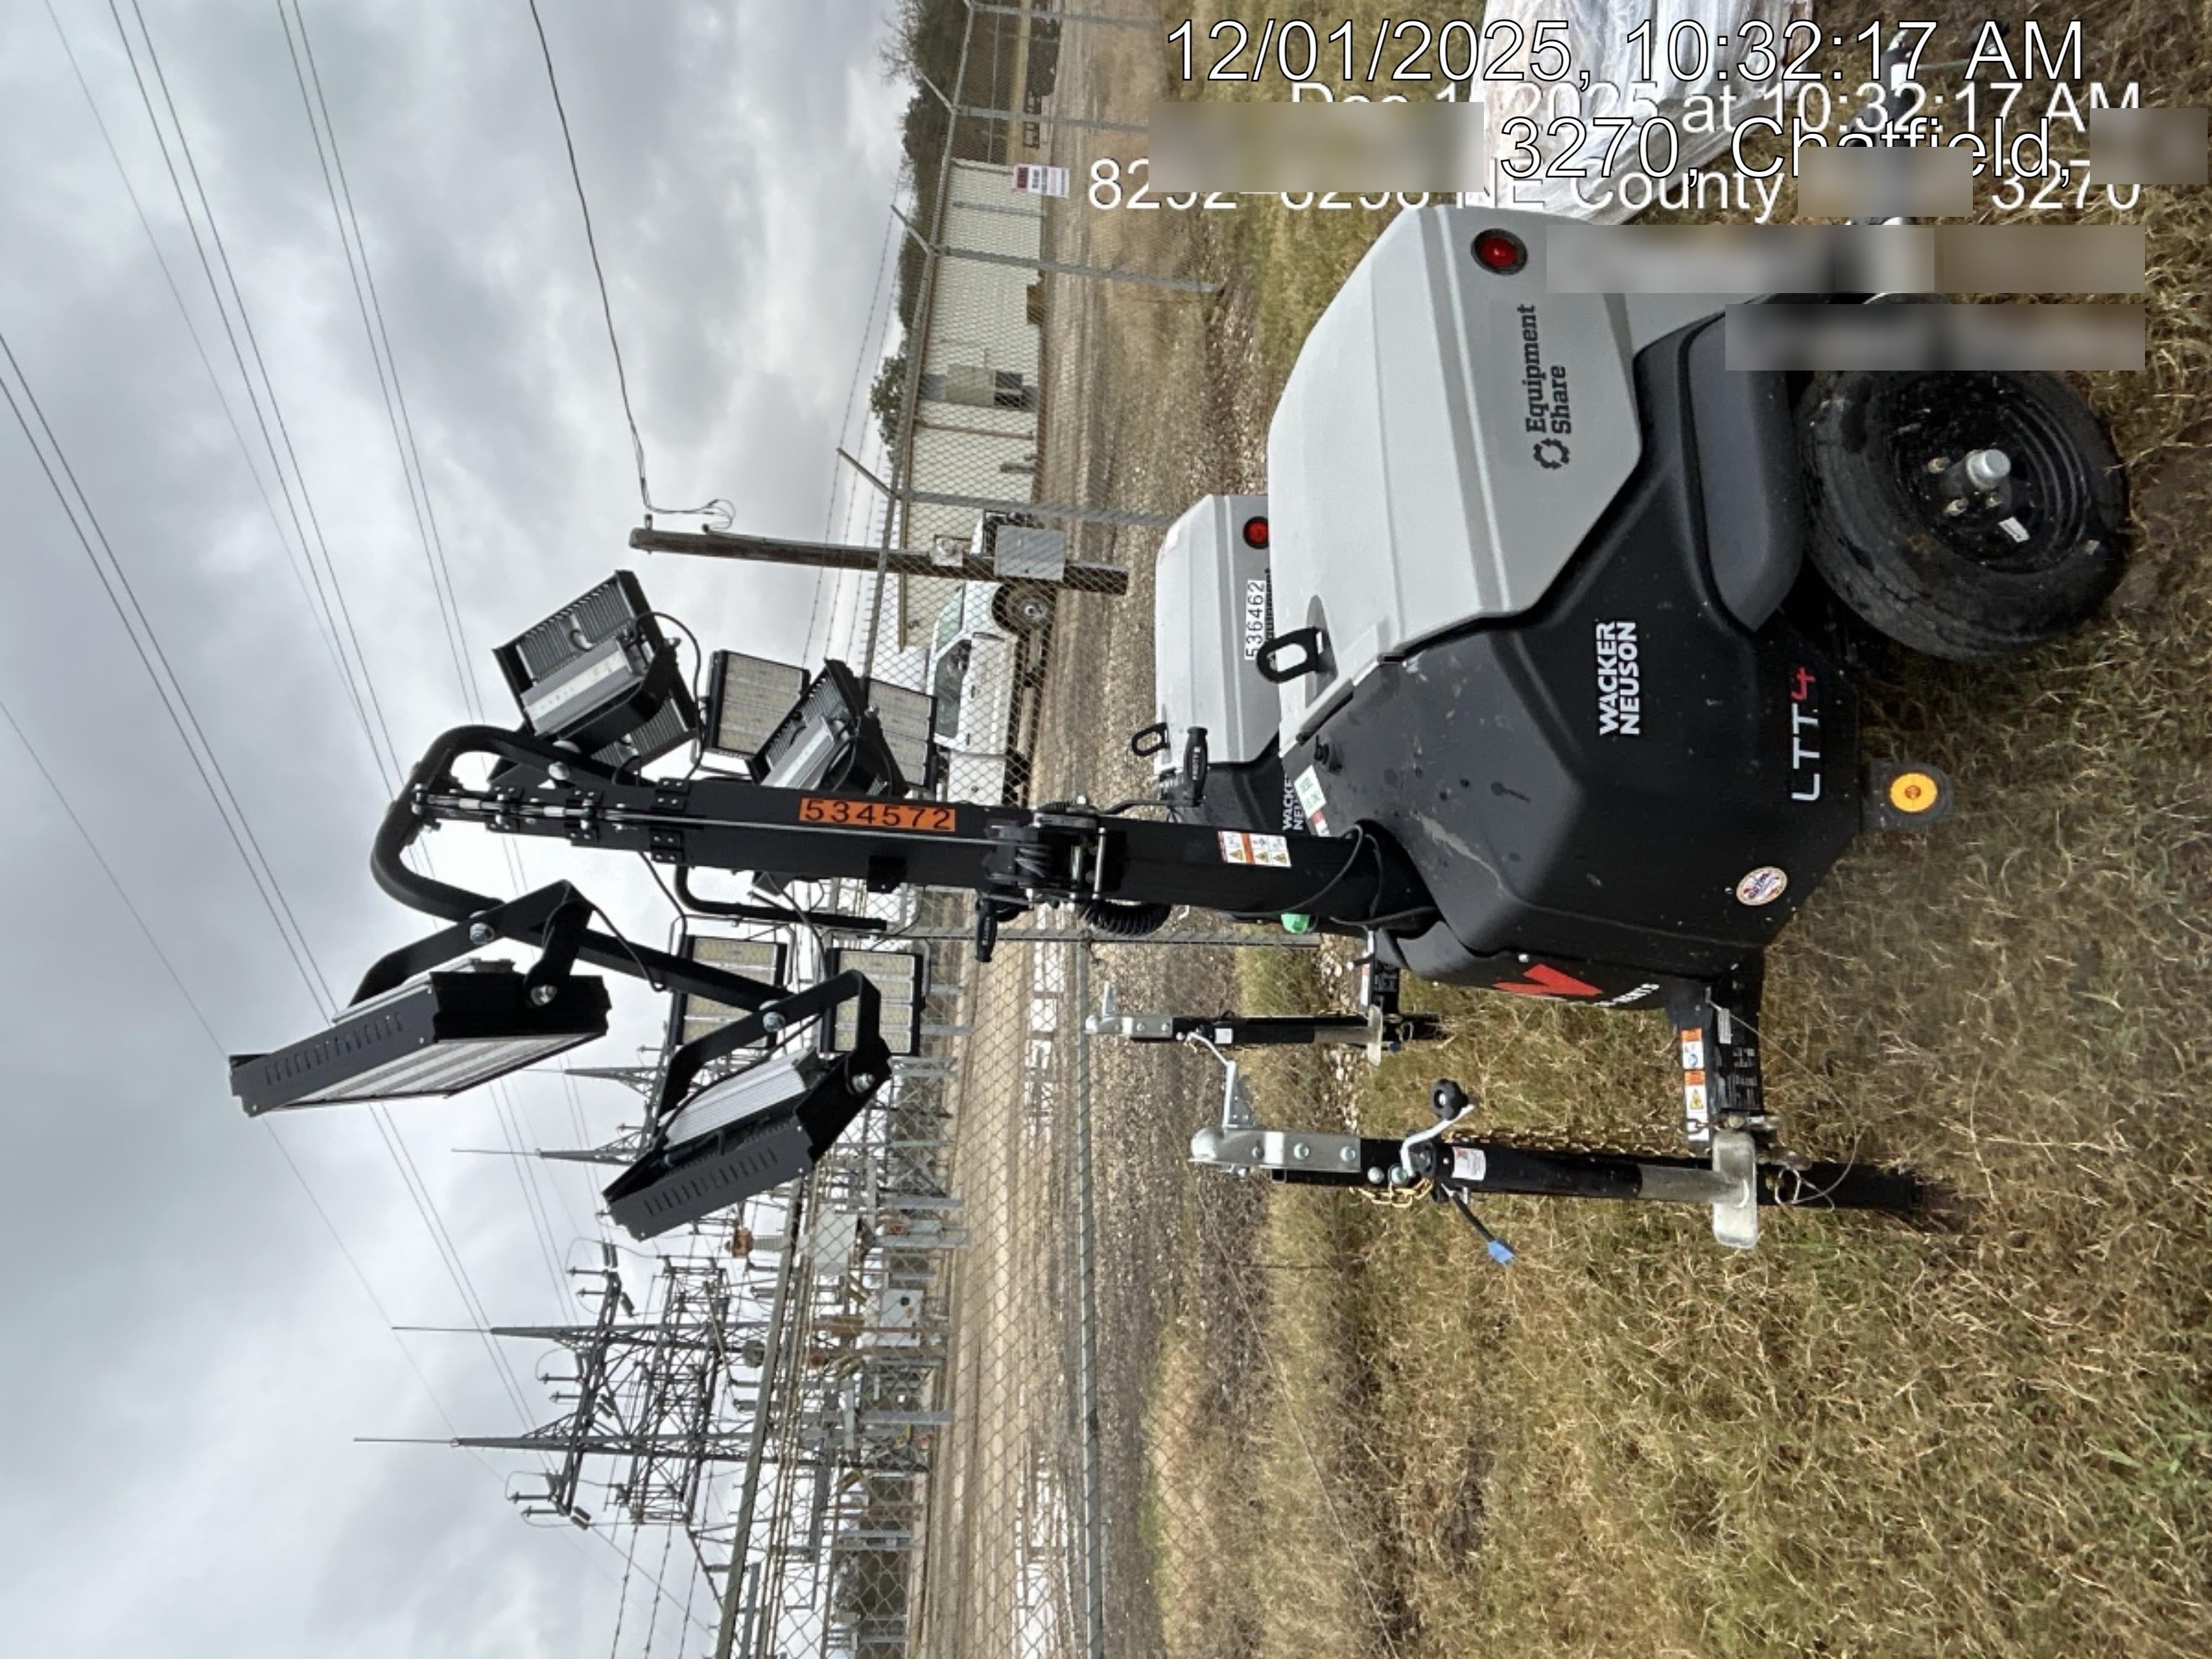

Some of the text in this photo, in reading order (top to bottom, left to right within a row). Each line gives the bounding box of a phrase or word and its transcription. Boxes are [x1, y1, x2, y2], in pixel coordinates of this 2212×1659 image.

[1516, 304, 1549, 433] Equipment
[1550, 365, 1572, 434] Share
[1245, 582, 1266, 657] 536462
[1596, 621, 1620, 736] WACKER
[1616, 621, 1641, 735] NEUSON
[1790, 667, 1821, 801] LTT4
[805, 799, 952, 831] 534572
[1282, 773, 1294, 831] WACKE
